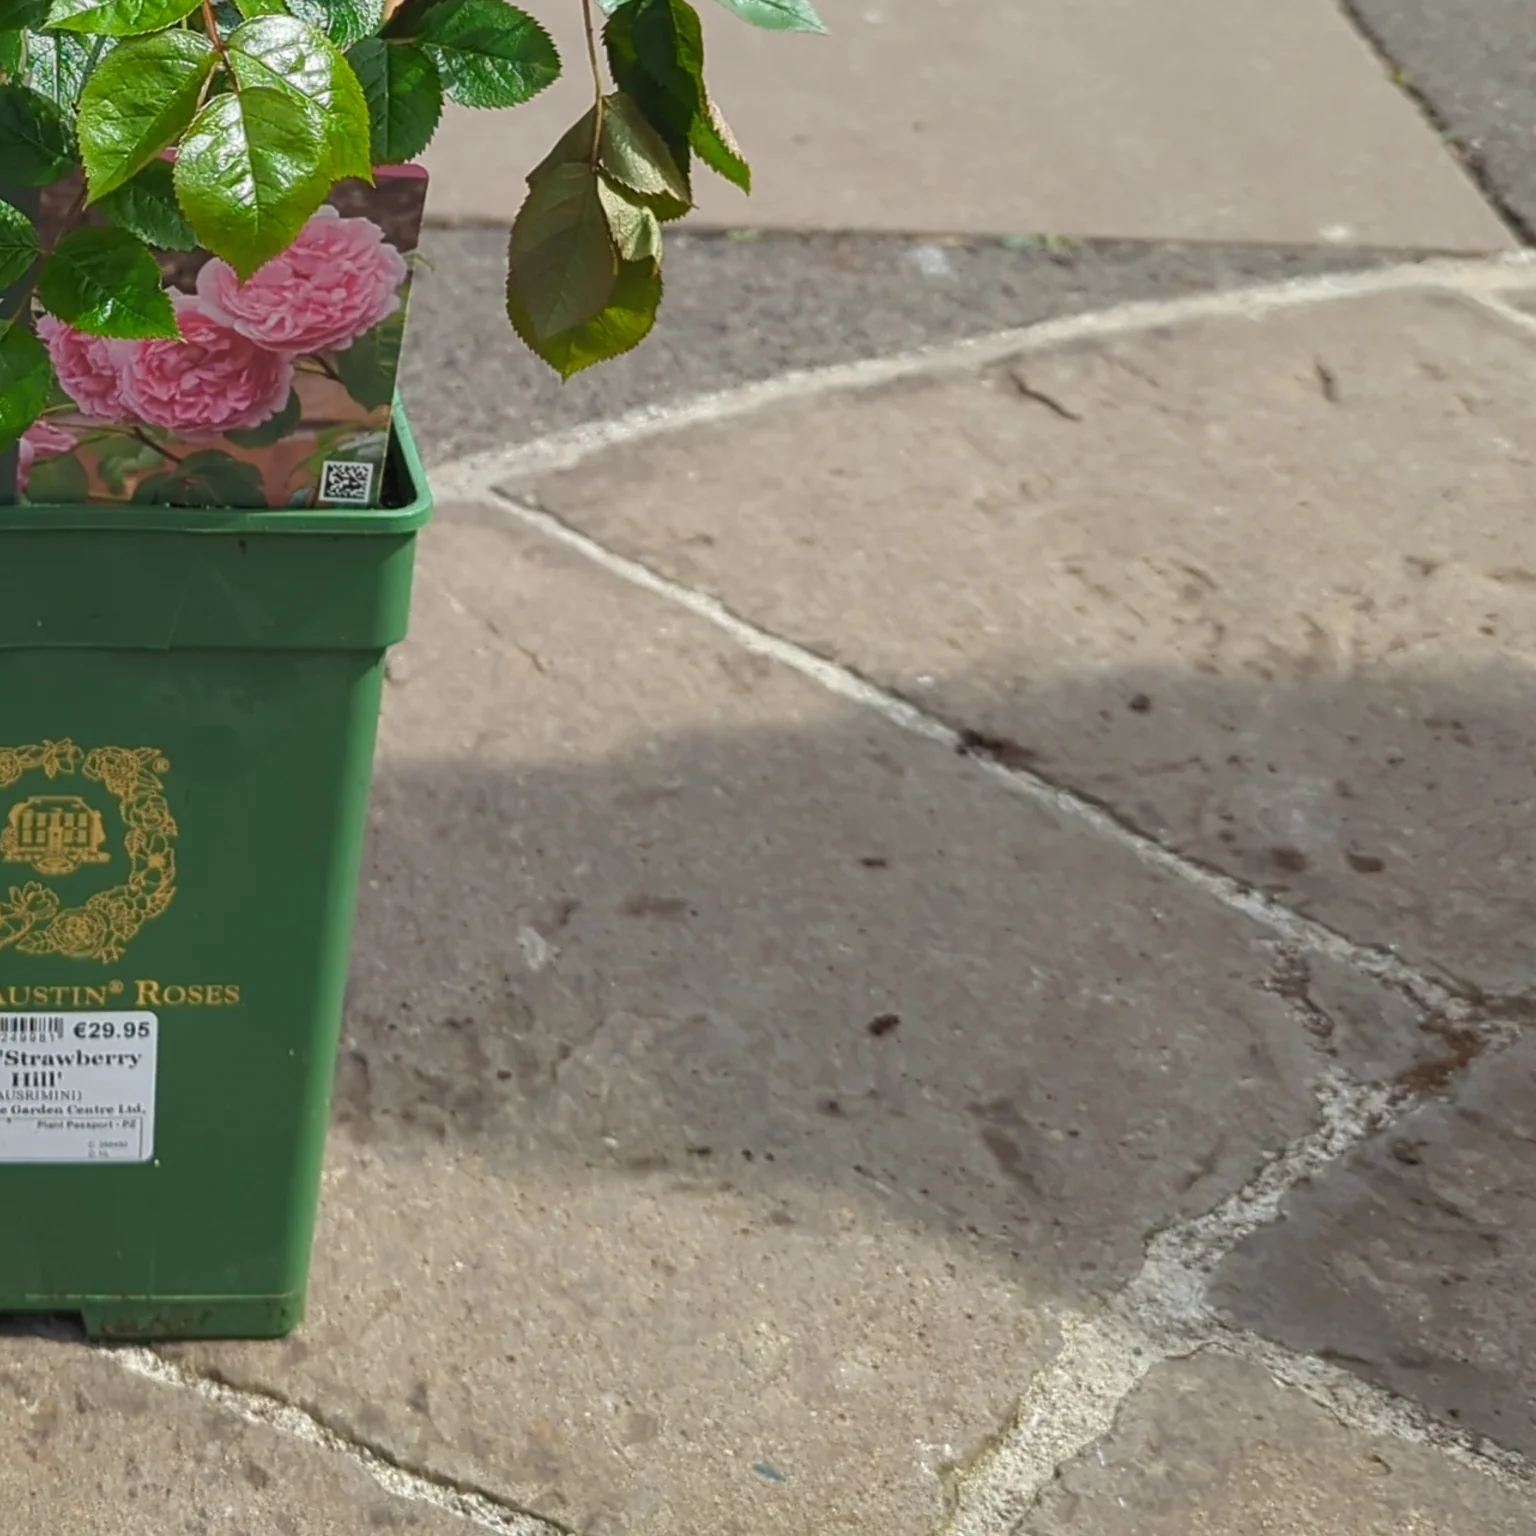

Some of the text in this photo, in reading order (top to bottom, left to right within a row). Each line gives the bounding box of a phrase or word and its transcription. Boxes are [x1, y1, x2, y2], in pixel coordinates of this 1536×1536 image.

[134, 978, 241, 1006] ROSES
[73, 1021, 151, 1039] €29.95
[10, 1103, 64, 1115] Garden
[67, 1104, 115, 1115] Centre
